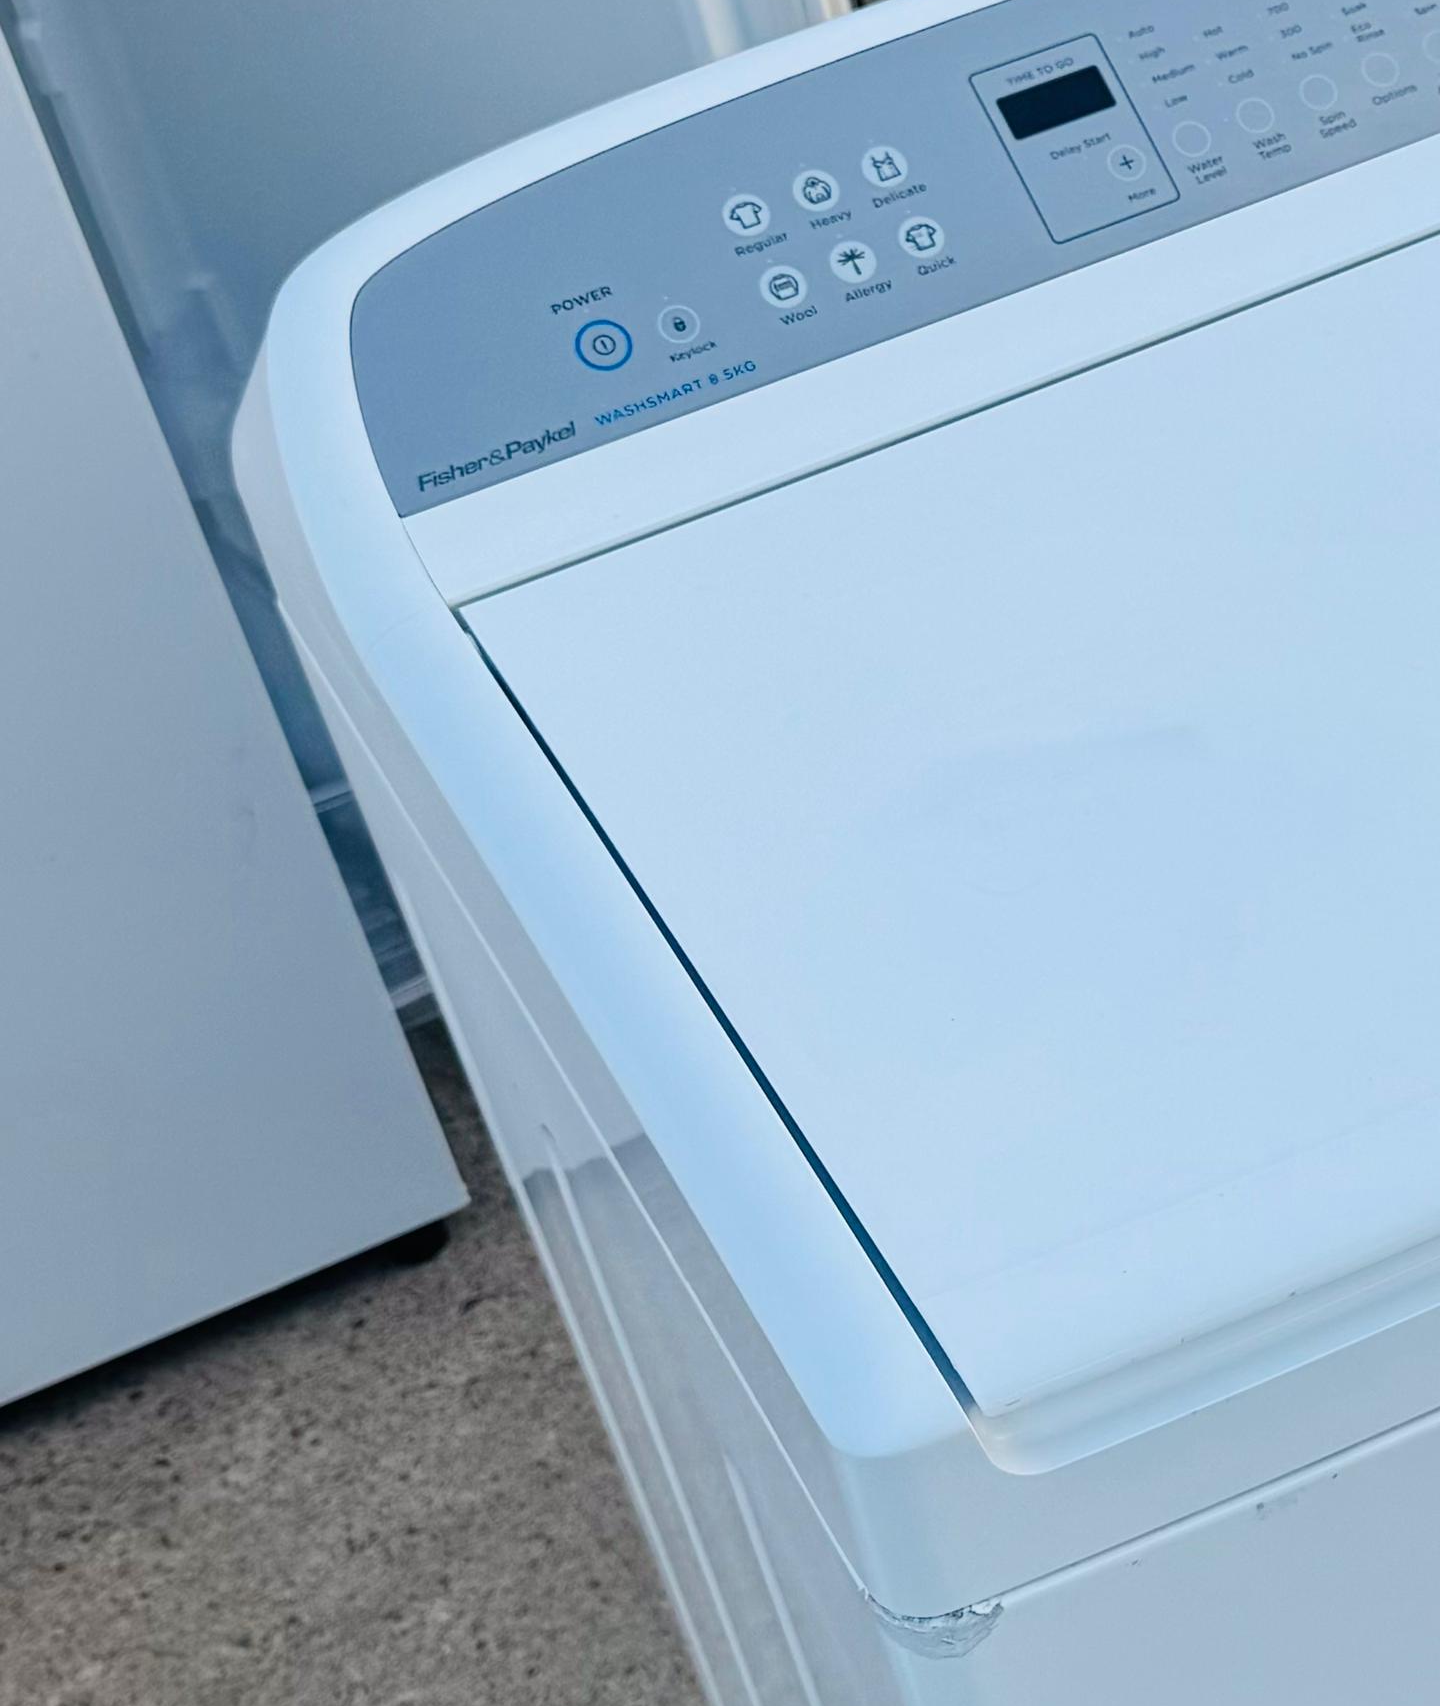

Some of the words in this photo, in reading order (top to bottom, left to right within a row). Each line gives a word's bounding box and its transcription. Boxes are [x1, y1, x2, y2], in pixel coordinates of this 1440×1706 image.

[1128, 24, 1155, 39] Auto
[1202, 25, 1224, 39] Hot
[1215, 43, 1249, 62] Warm
[1006, 71, 1034, 86] TIME
[1036, 64, 1054, 77] TO
[1055, 57, 1075, 70] GO
[1151, 62, 1196, 84] Medium
[1227, 69, 1255, 84] Cold
[1371, 84, 1418, 106] Options
[1319, 118, 1358, 139] Speed
[1050, 142, 1083, 161] Delay
[1083, 132, 1112, 149] Start
[1253, 132, 1287, 150] Wash
[1257, 143, 1293, 161] Temp
[1186, 155, 1224, 175] Water
[1195, 167, 1228, 186] Level
[872, 182, 928, 209] Delicate
[809, 209, 853, 230] Heavy
[734, 231, 788, 257] Regular
[917, 254, 957, 277] Quick
[551, 285, 613, 316] POWER
[845, 279, 894, 303] Allergy
[780, 305, 819, 326] Wool
[669, 340, 718, 364] Keylock
[418, 420, 577, 493] Fisher&Paykel
[594, 379, 703, 427] WASHSMART
